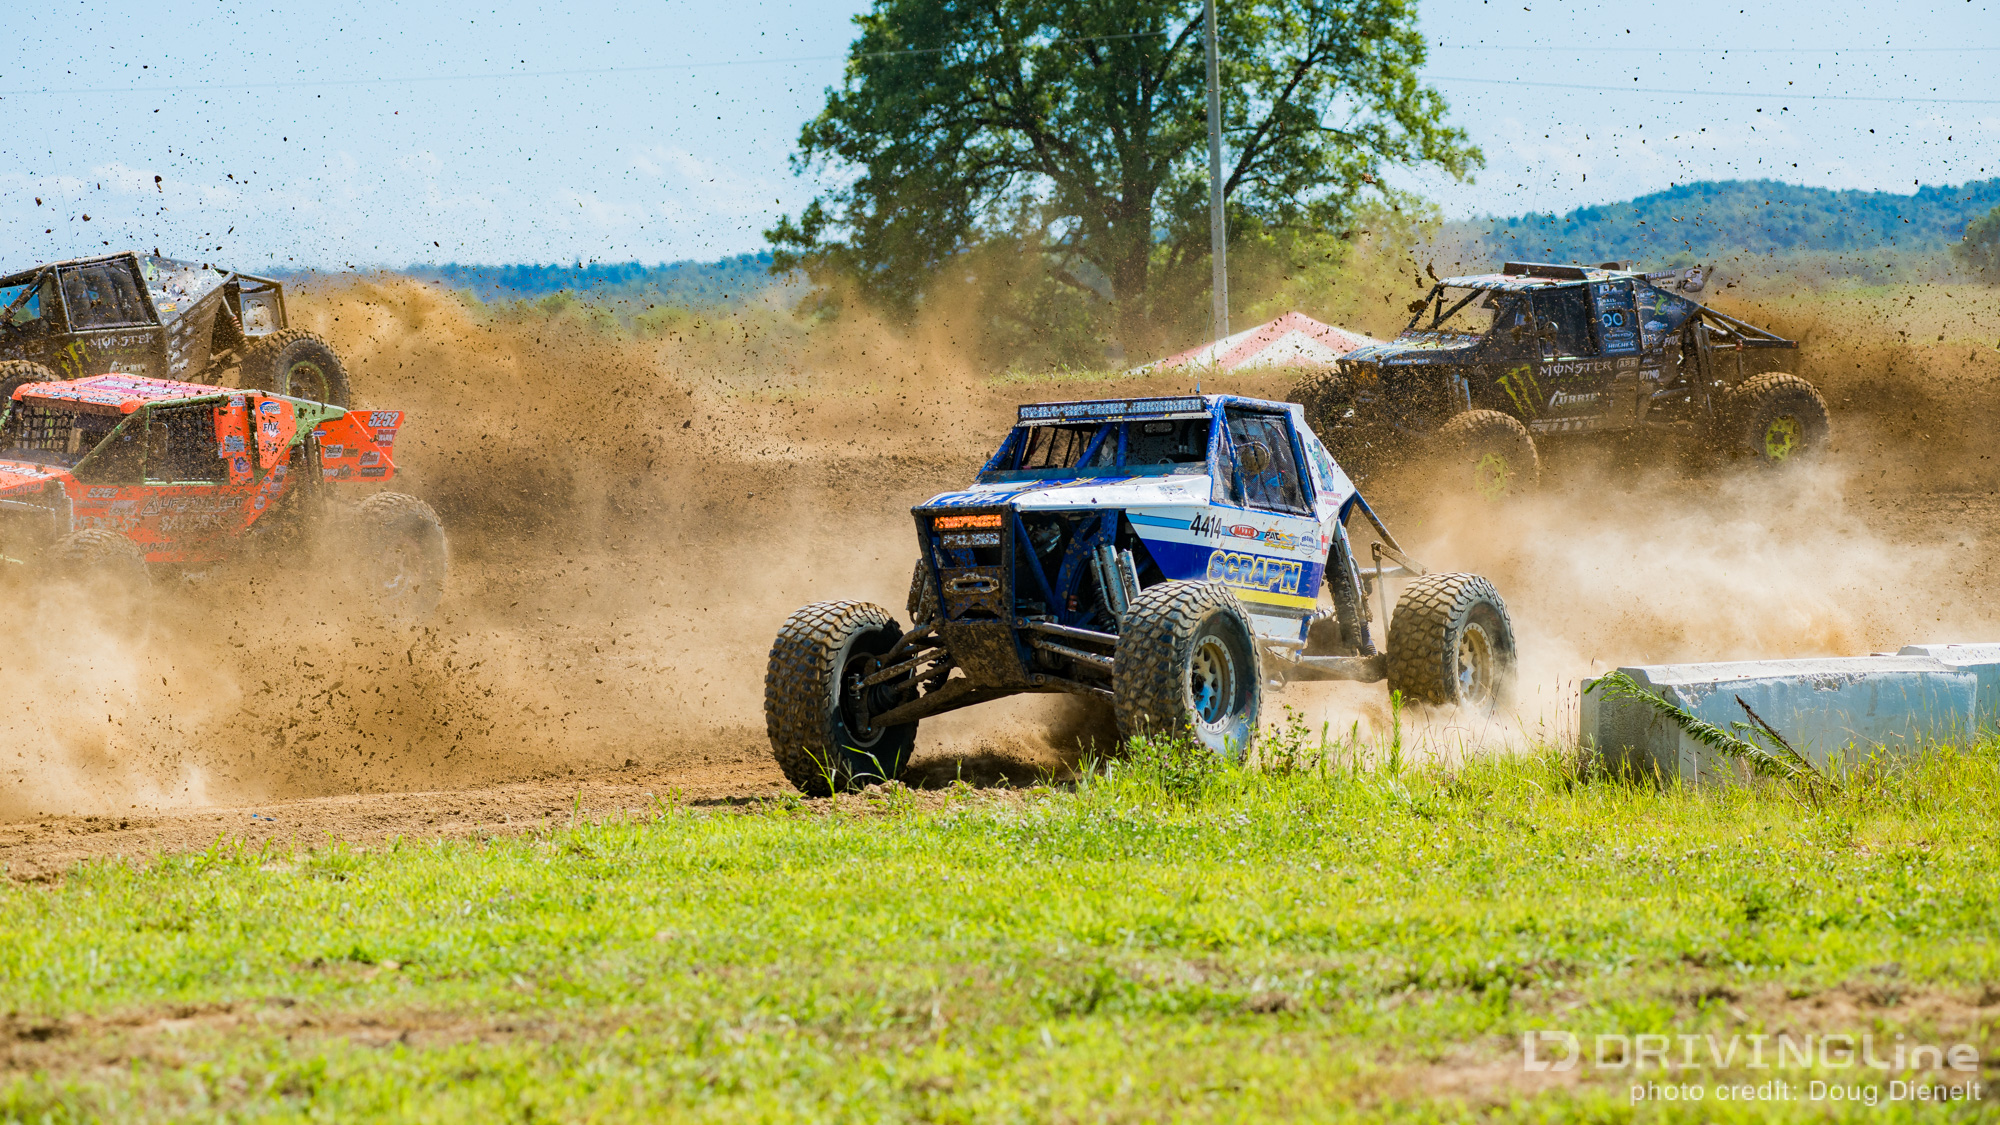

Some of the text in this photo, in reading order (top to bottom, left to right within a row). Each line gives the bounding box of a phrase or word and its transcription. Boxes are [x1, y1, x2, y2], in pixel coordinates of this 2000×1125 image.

[1540, 361, 1613, 376] MONSTER
[368, 412, 400, 427] 5252
[1190, 514, 1222, 539] 4414
[1264, 530, 1281, 541] PAC
